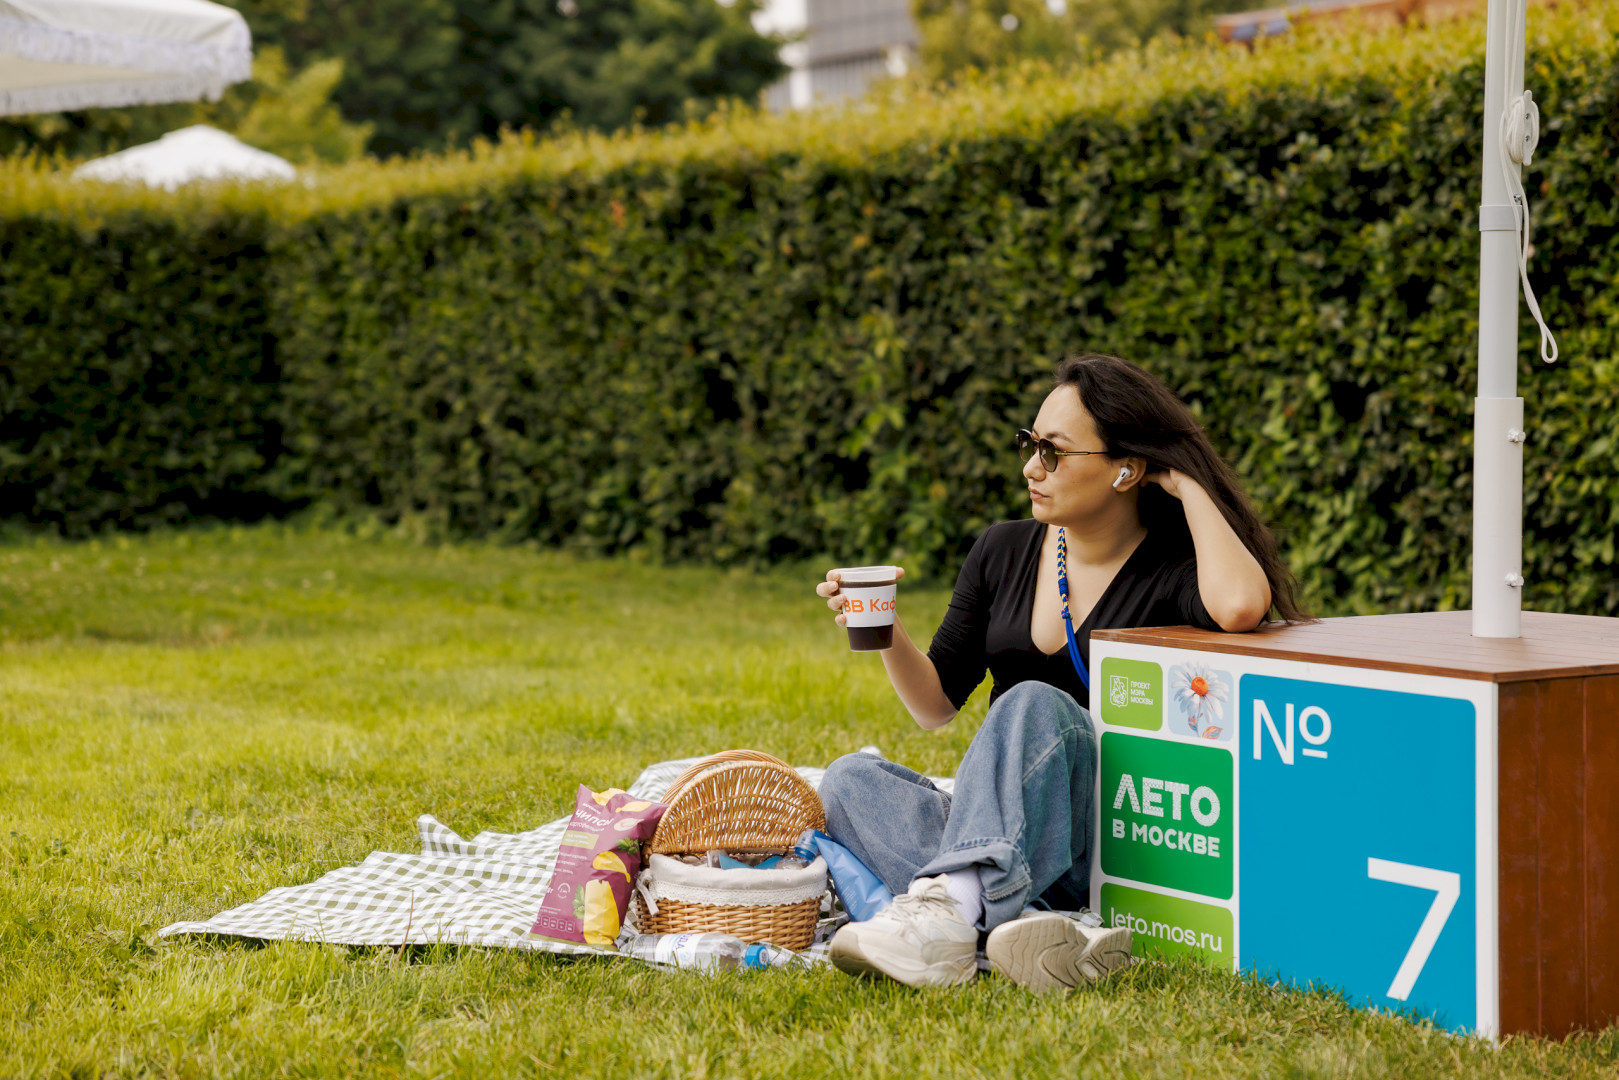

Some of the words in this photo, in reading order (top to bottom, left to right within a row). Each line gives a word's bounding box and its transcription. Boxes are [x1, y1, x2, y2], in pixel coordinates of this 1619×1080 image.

[1130, 680, 1151, 690] ПРОЕКТ
[1130, 688, 1146, 697] МЭРА
[1130, 696, 1154, 705] МОСКВЫ
[1112, 773, 1221, 827] ЛЕТО
[1112, 818, 1126, 839] В
[1131, 821, 1221, 858] МОСКВЕ
[1110, 907, 1223, 953] leto.mos.ru
[1367, 856, 1461, 1001] 7
